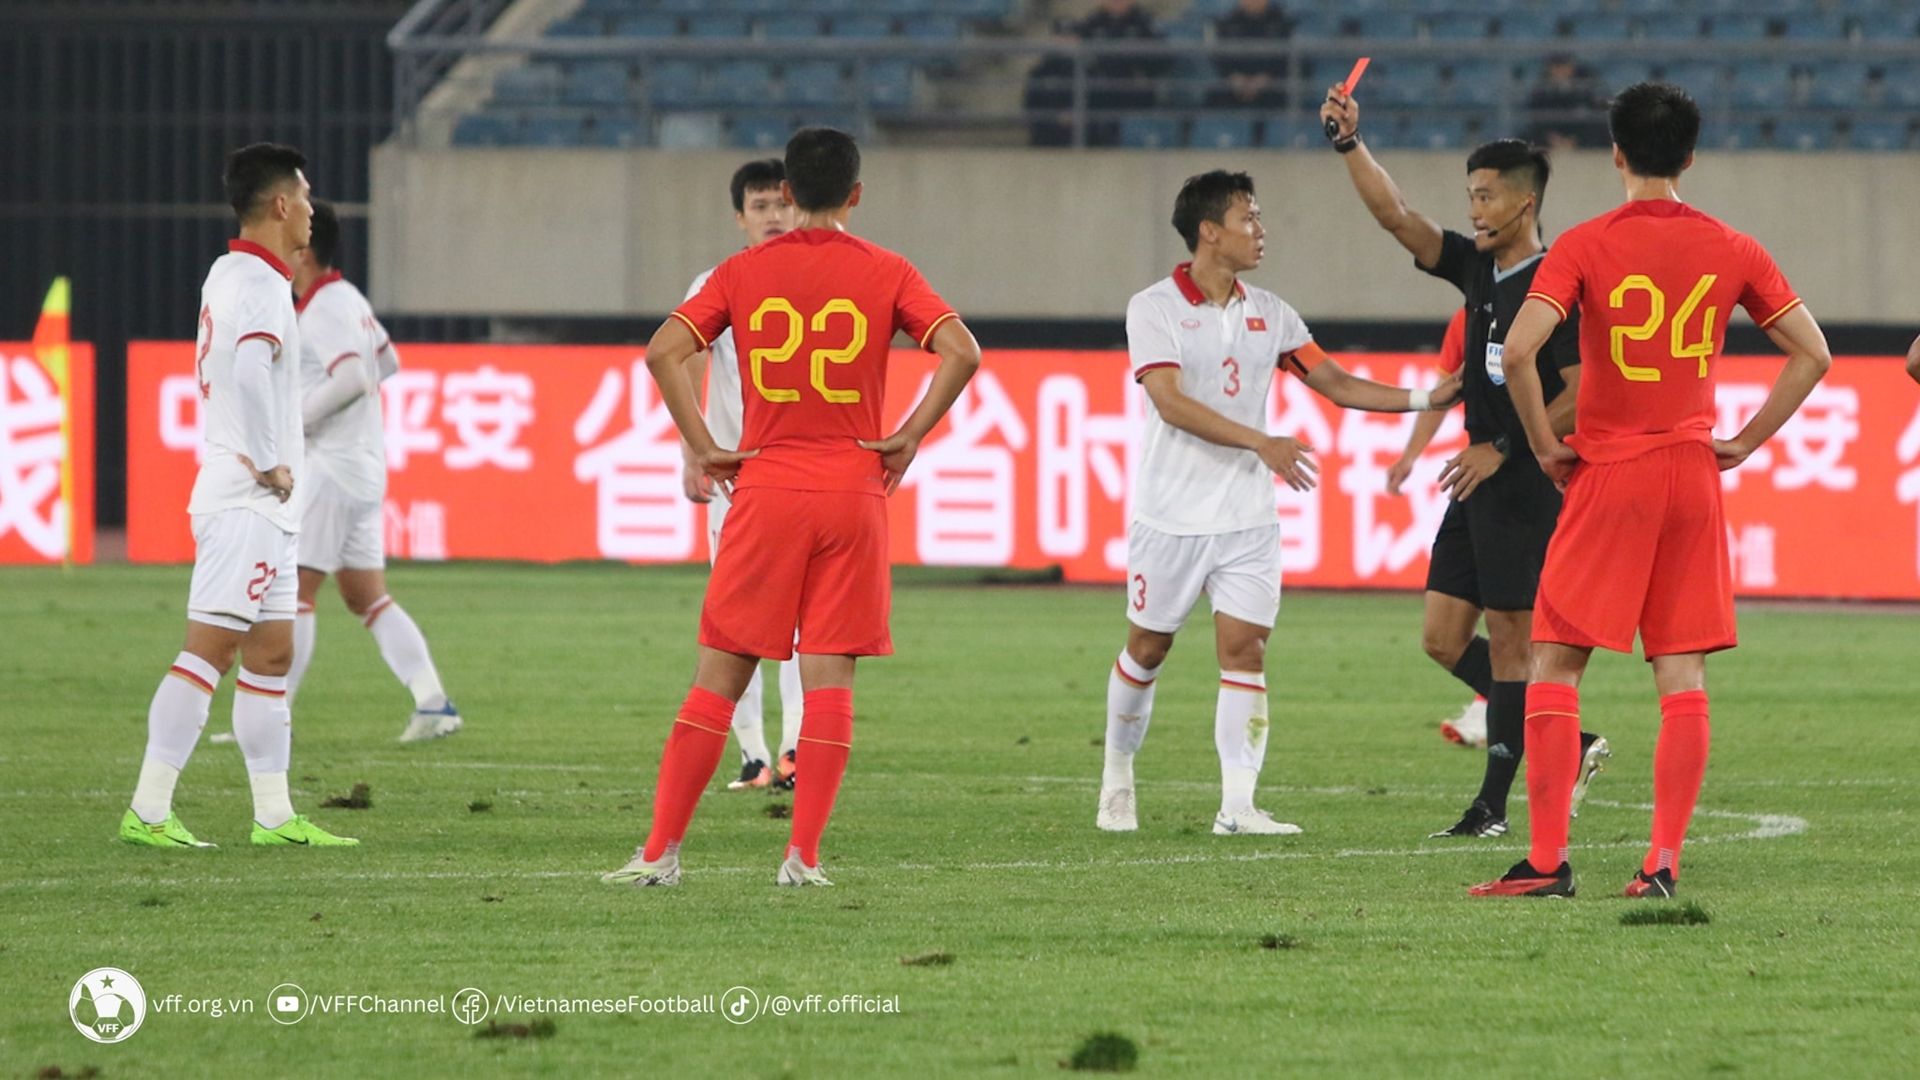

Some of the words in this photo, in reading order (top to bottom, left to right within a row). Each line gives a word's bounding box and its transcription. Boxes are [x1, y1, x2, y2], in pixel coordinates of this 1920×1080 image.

[749, 297, 868, 403] 22
[1609, 274, 1718, 382] 24
[1222, 357, 1240, 397] 3
[1133, 572, 1147, 612] 3
